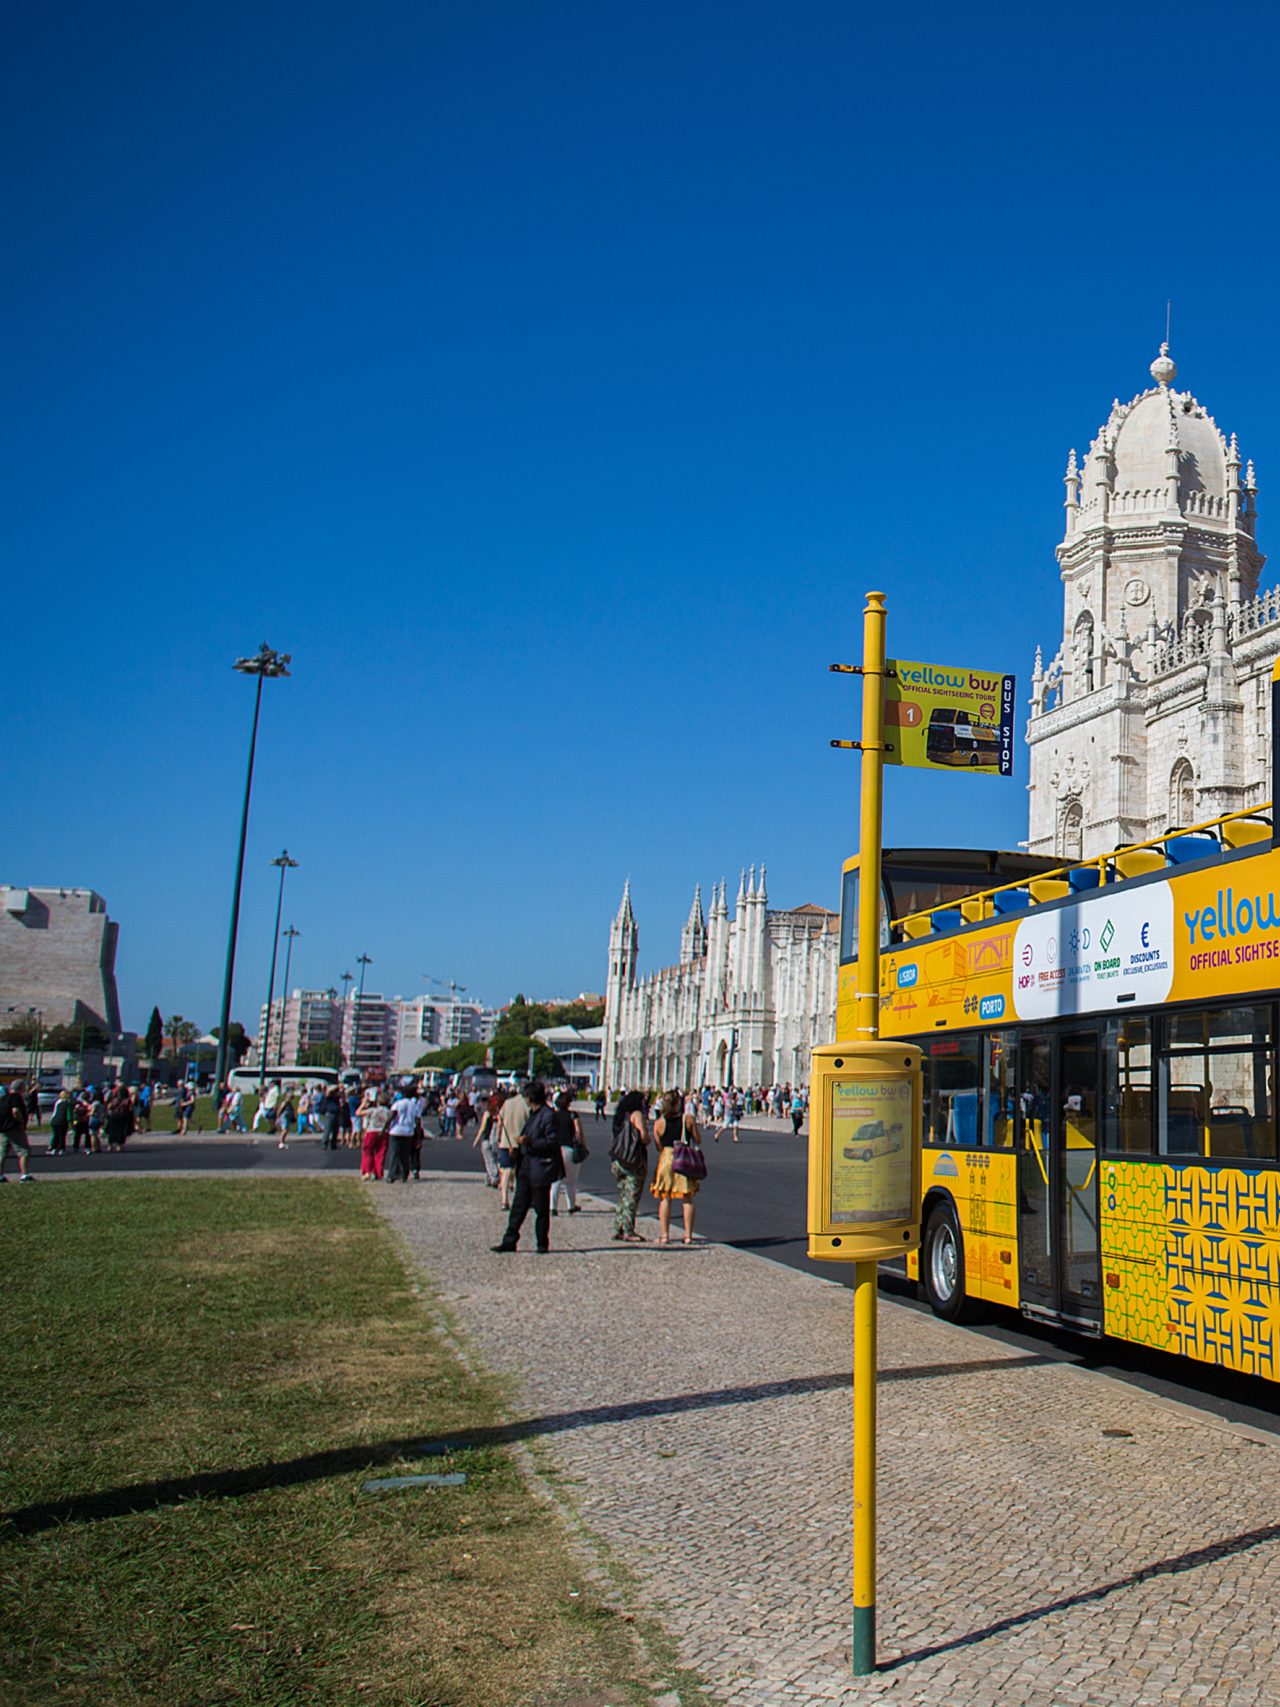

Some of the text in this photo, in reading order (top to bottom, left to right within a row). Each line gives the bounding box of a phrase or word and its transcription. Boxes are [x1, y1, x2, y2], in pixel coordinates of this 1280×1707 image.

[969, 673, 999, 692] bus
[902, 684, 997, 702] OFFICIAL SIGHTSEEING TOURS
[906, 708, 914, 722] 1
[1002, 679, 1012, 772] BUS STOP
[1102, 957, 1121, 970] BOARD
[1130, 949, 1160, 965] DISCOUNTS
[1190, 949, 1233, 971] OFFICIAL
[899, 967, 916, 984] LISBOA
[1018, 974, 1031, 989] HOP
[1038, 970, 1049, 981] FREE
[1049, 968, 1066, 979] ACCESS
[981, 998, 1003, 1015] PORTO
